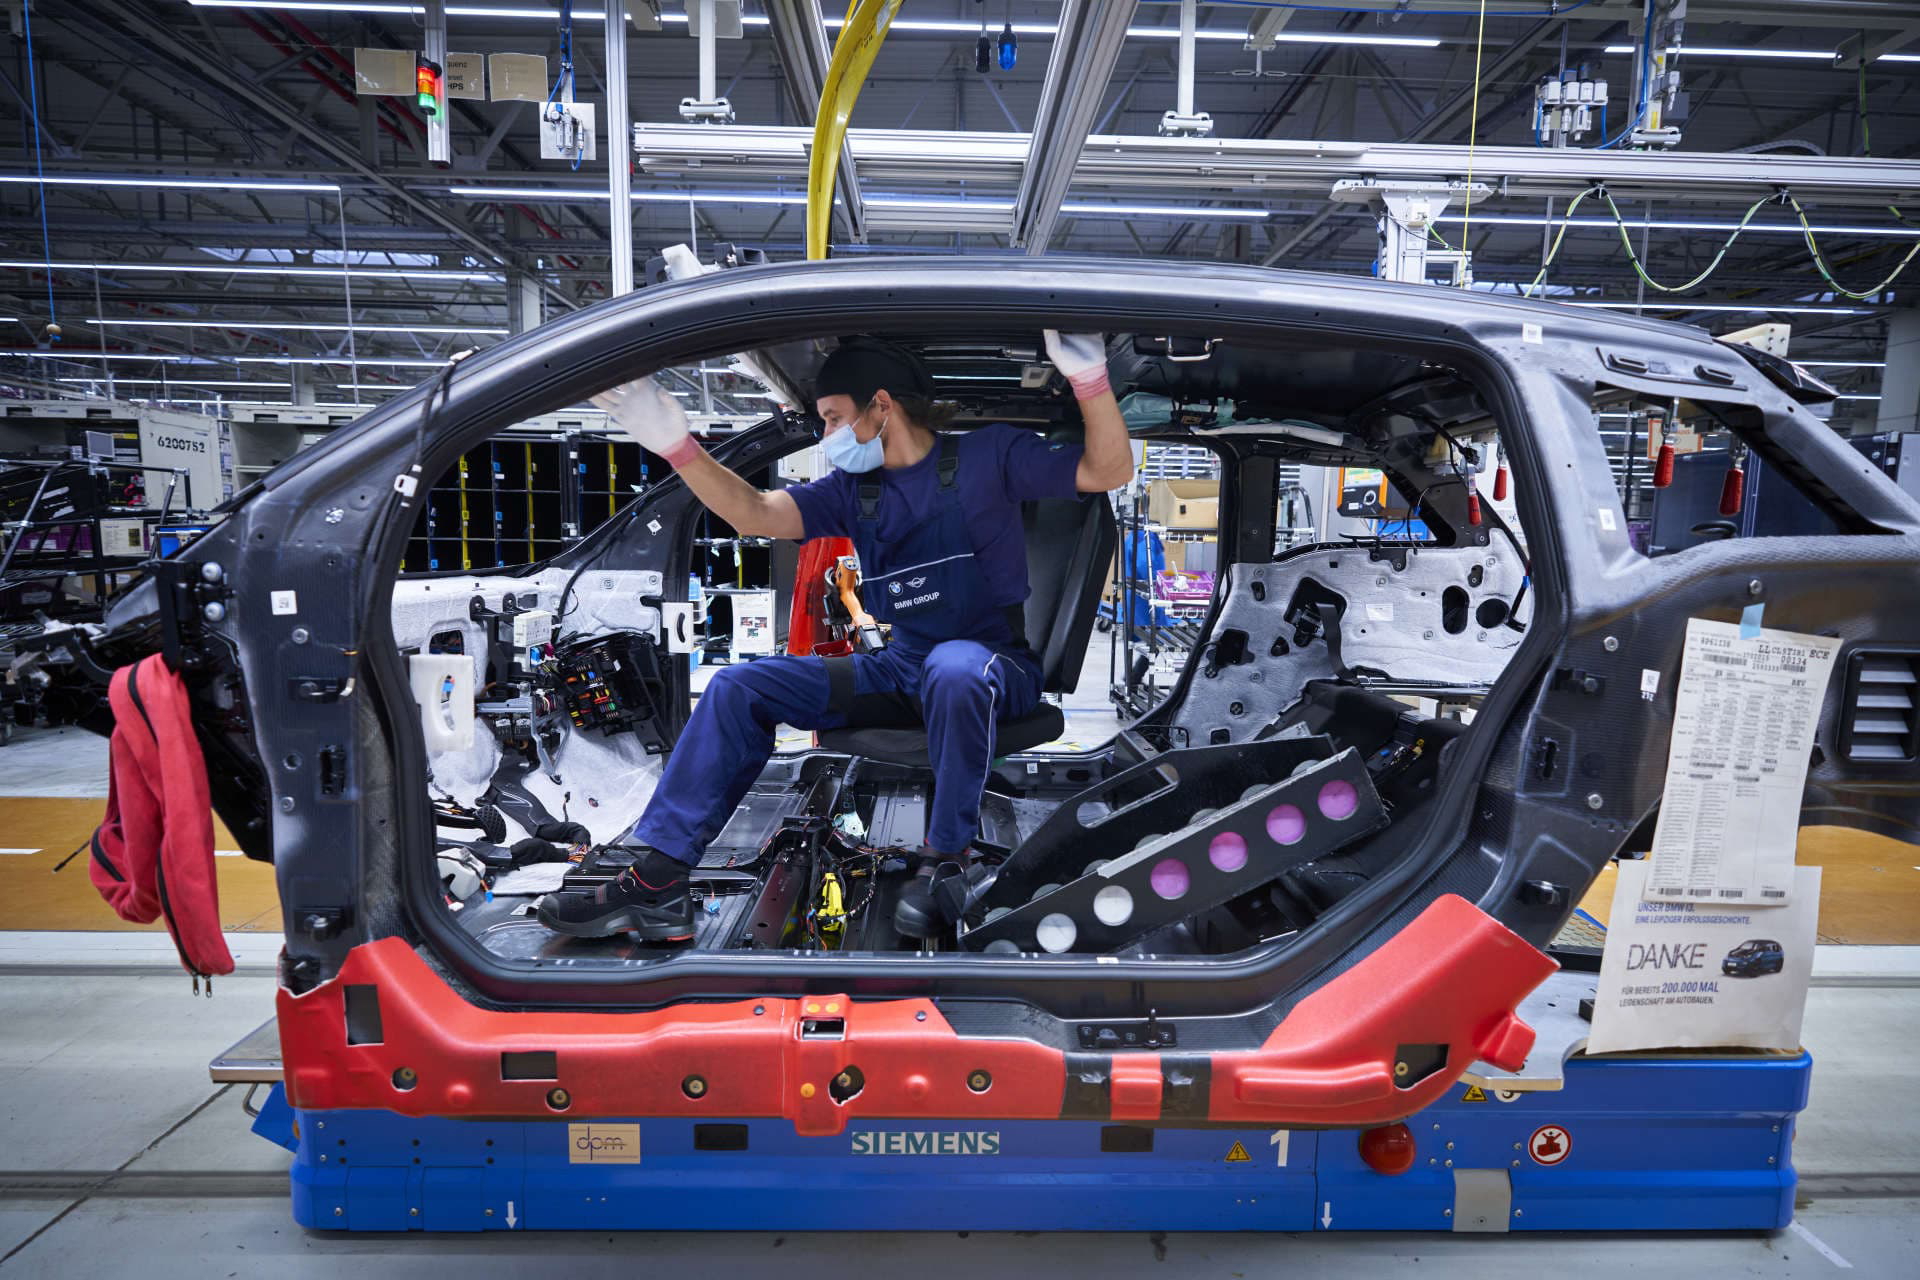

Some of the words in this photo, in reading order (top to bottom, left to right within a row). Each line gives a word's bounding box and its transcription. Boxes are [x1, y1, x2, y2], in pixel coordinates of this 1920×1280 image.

[158, 435, 206, 454] 6200752
[894, 599, 913, 610] BMW
[913, 591, 940, 605] GROUP
[1638, 901, 1664, 912] UNSER
[1665, 902, 1683, 912] BMW
[1627, 943, 1708, 970] DANKE
[1635, 985, 1660, 994] BEREITS
[1661, 982, 1698, 993] 200.000
[1699, 981, 1719, 993] MAL
[576, 1126, 626, 1160] dpm
[852, 1131, 1000, 1155] SIEMENS
[1271, 1129, 1290, 1167] 1
